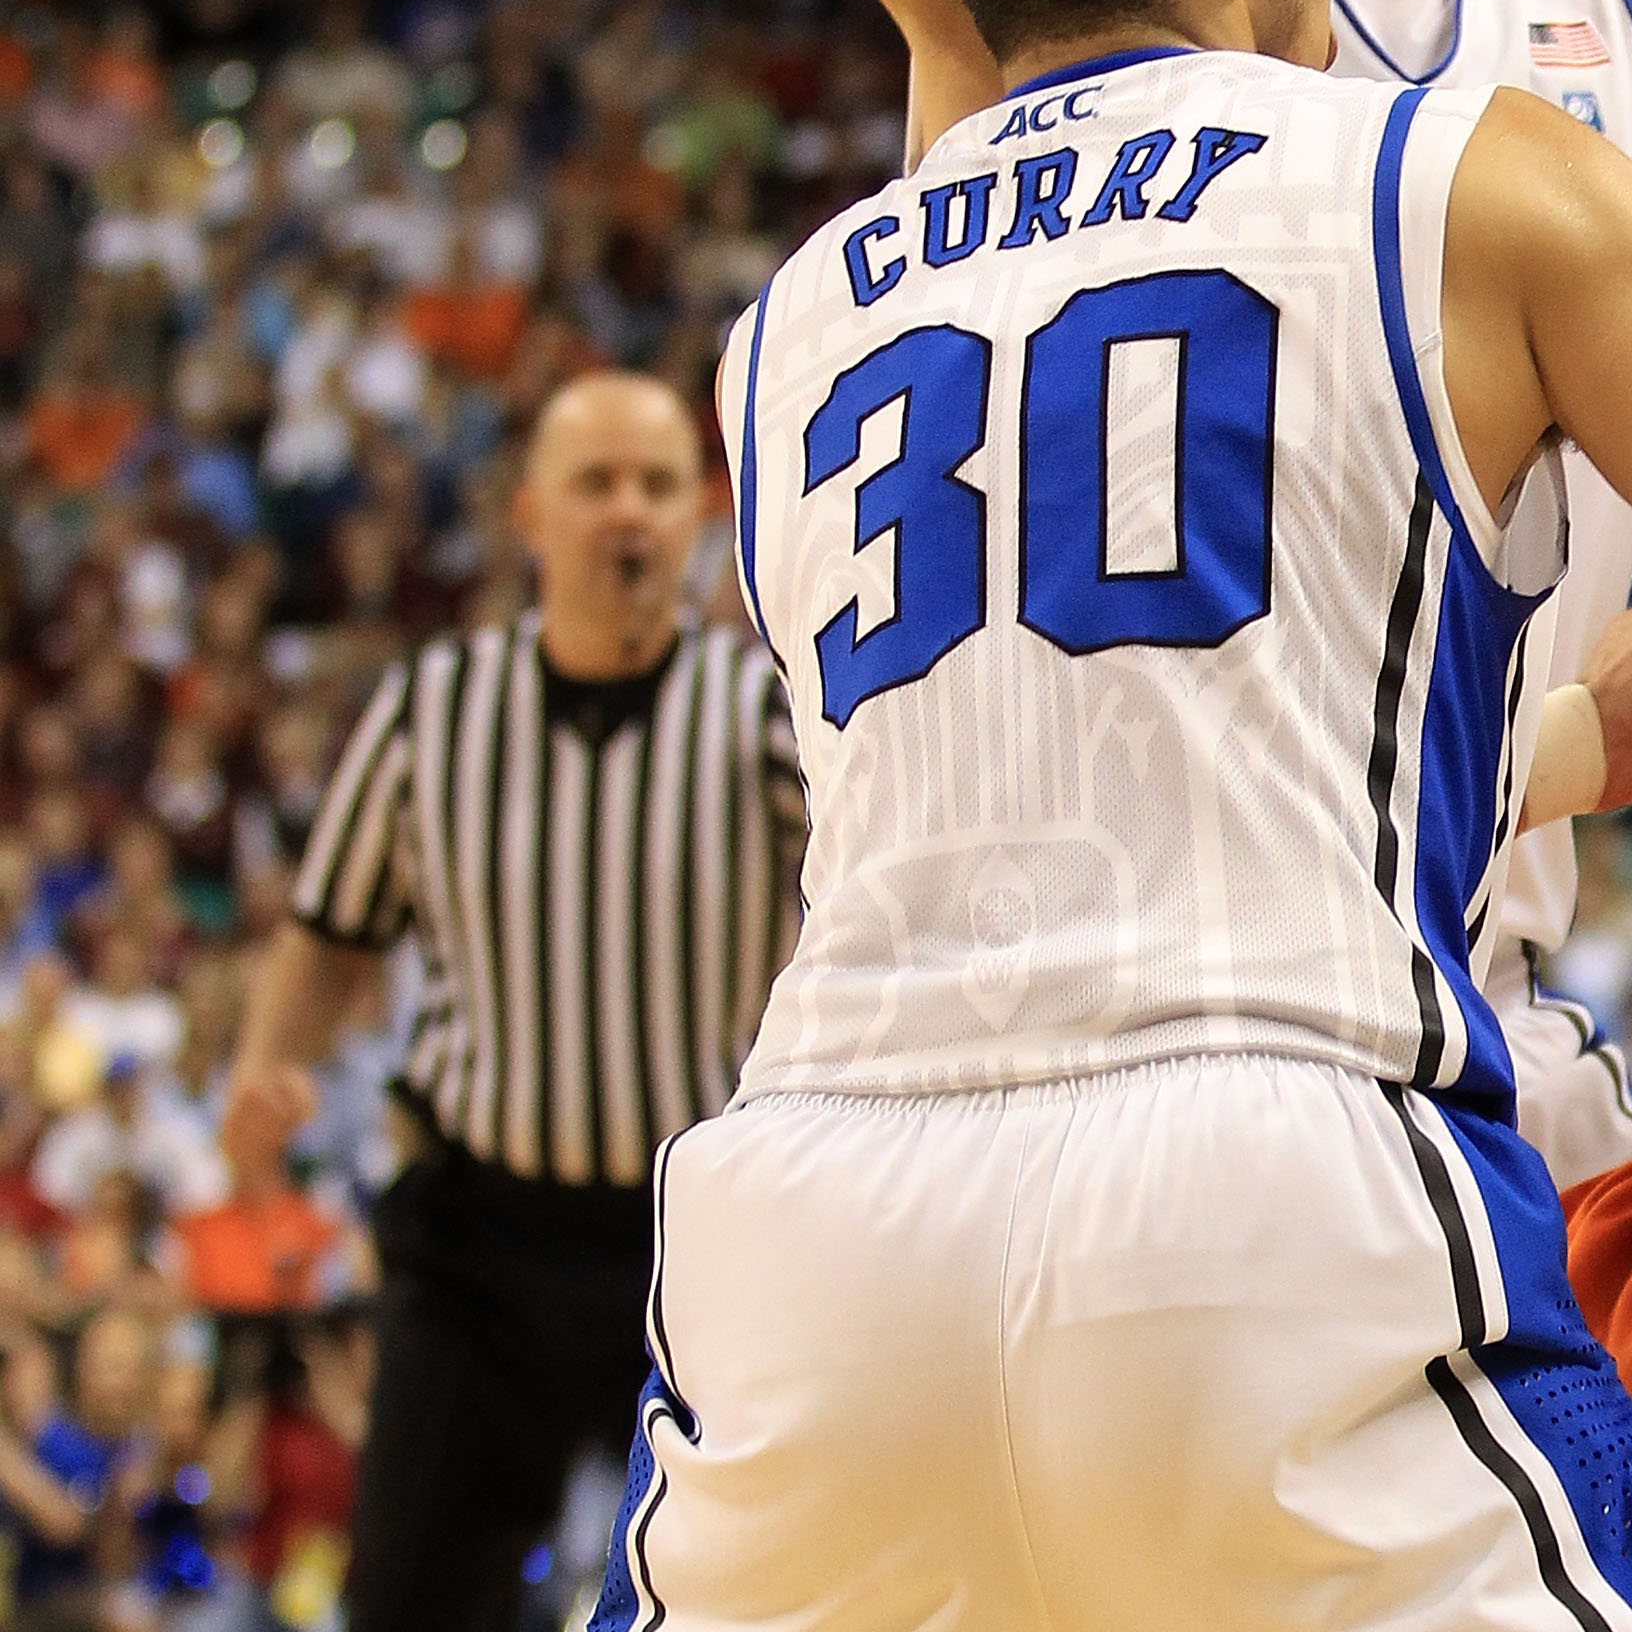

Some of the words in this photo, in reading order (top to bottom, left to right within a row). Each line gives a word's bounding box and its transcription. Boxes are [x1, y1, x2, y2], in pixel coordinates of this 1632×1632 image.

[989, 85, 1100, 144] ACC
[843, 127, 1268, 307] CURRY
[803, 268, 1280, 730] 30
